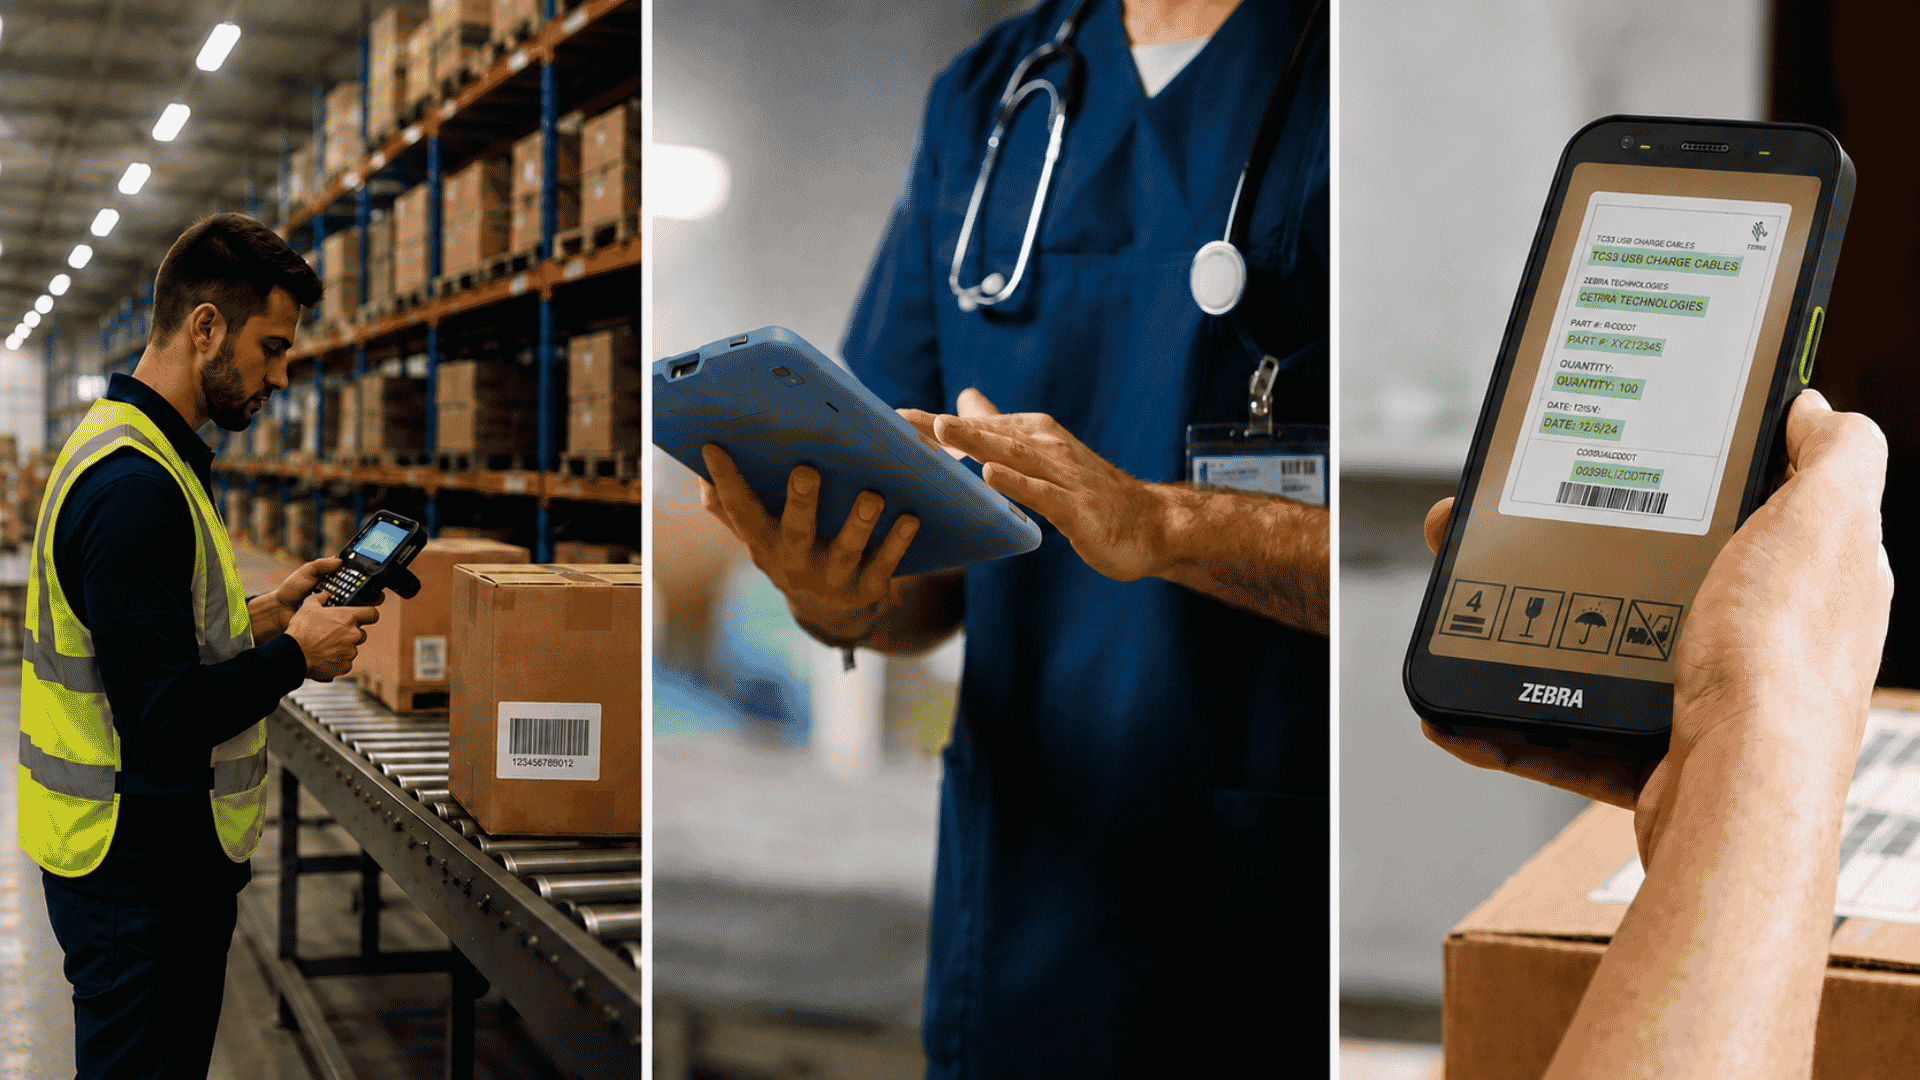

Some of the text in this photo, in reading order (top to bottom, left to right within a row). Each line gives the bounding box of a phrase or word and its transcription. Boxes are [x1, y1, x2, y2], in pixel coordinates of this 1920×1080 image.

[1617, 236, 1632, 245] USB
[1633, 237, 1664, 248] CHARGE
[1592, 250, 1739, 271] TCS3 USB CHARGE CABLES
[1620, 293, 1704, 312] TECHNOLOGIES
[1570, 318, 1593, 328] PART
[1566, 334, 1597, 346] PART
[1610, 338, 1662, 353] XYZ12345
[1559, 359, 1614, 374] QUANTITY:
[1556, 375, 1639, 395] QUANTITY: 100
[1547, 401, 1572, 412] DATE:
[1543, 417, 1618, 435] DATE: 12/5/24
[1466, 590, 1484, 612] 4
[1518, 682, 1584, 708] ZEBRA
